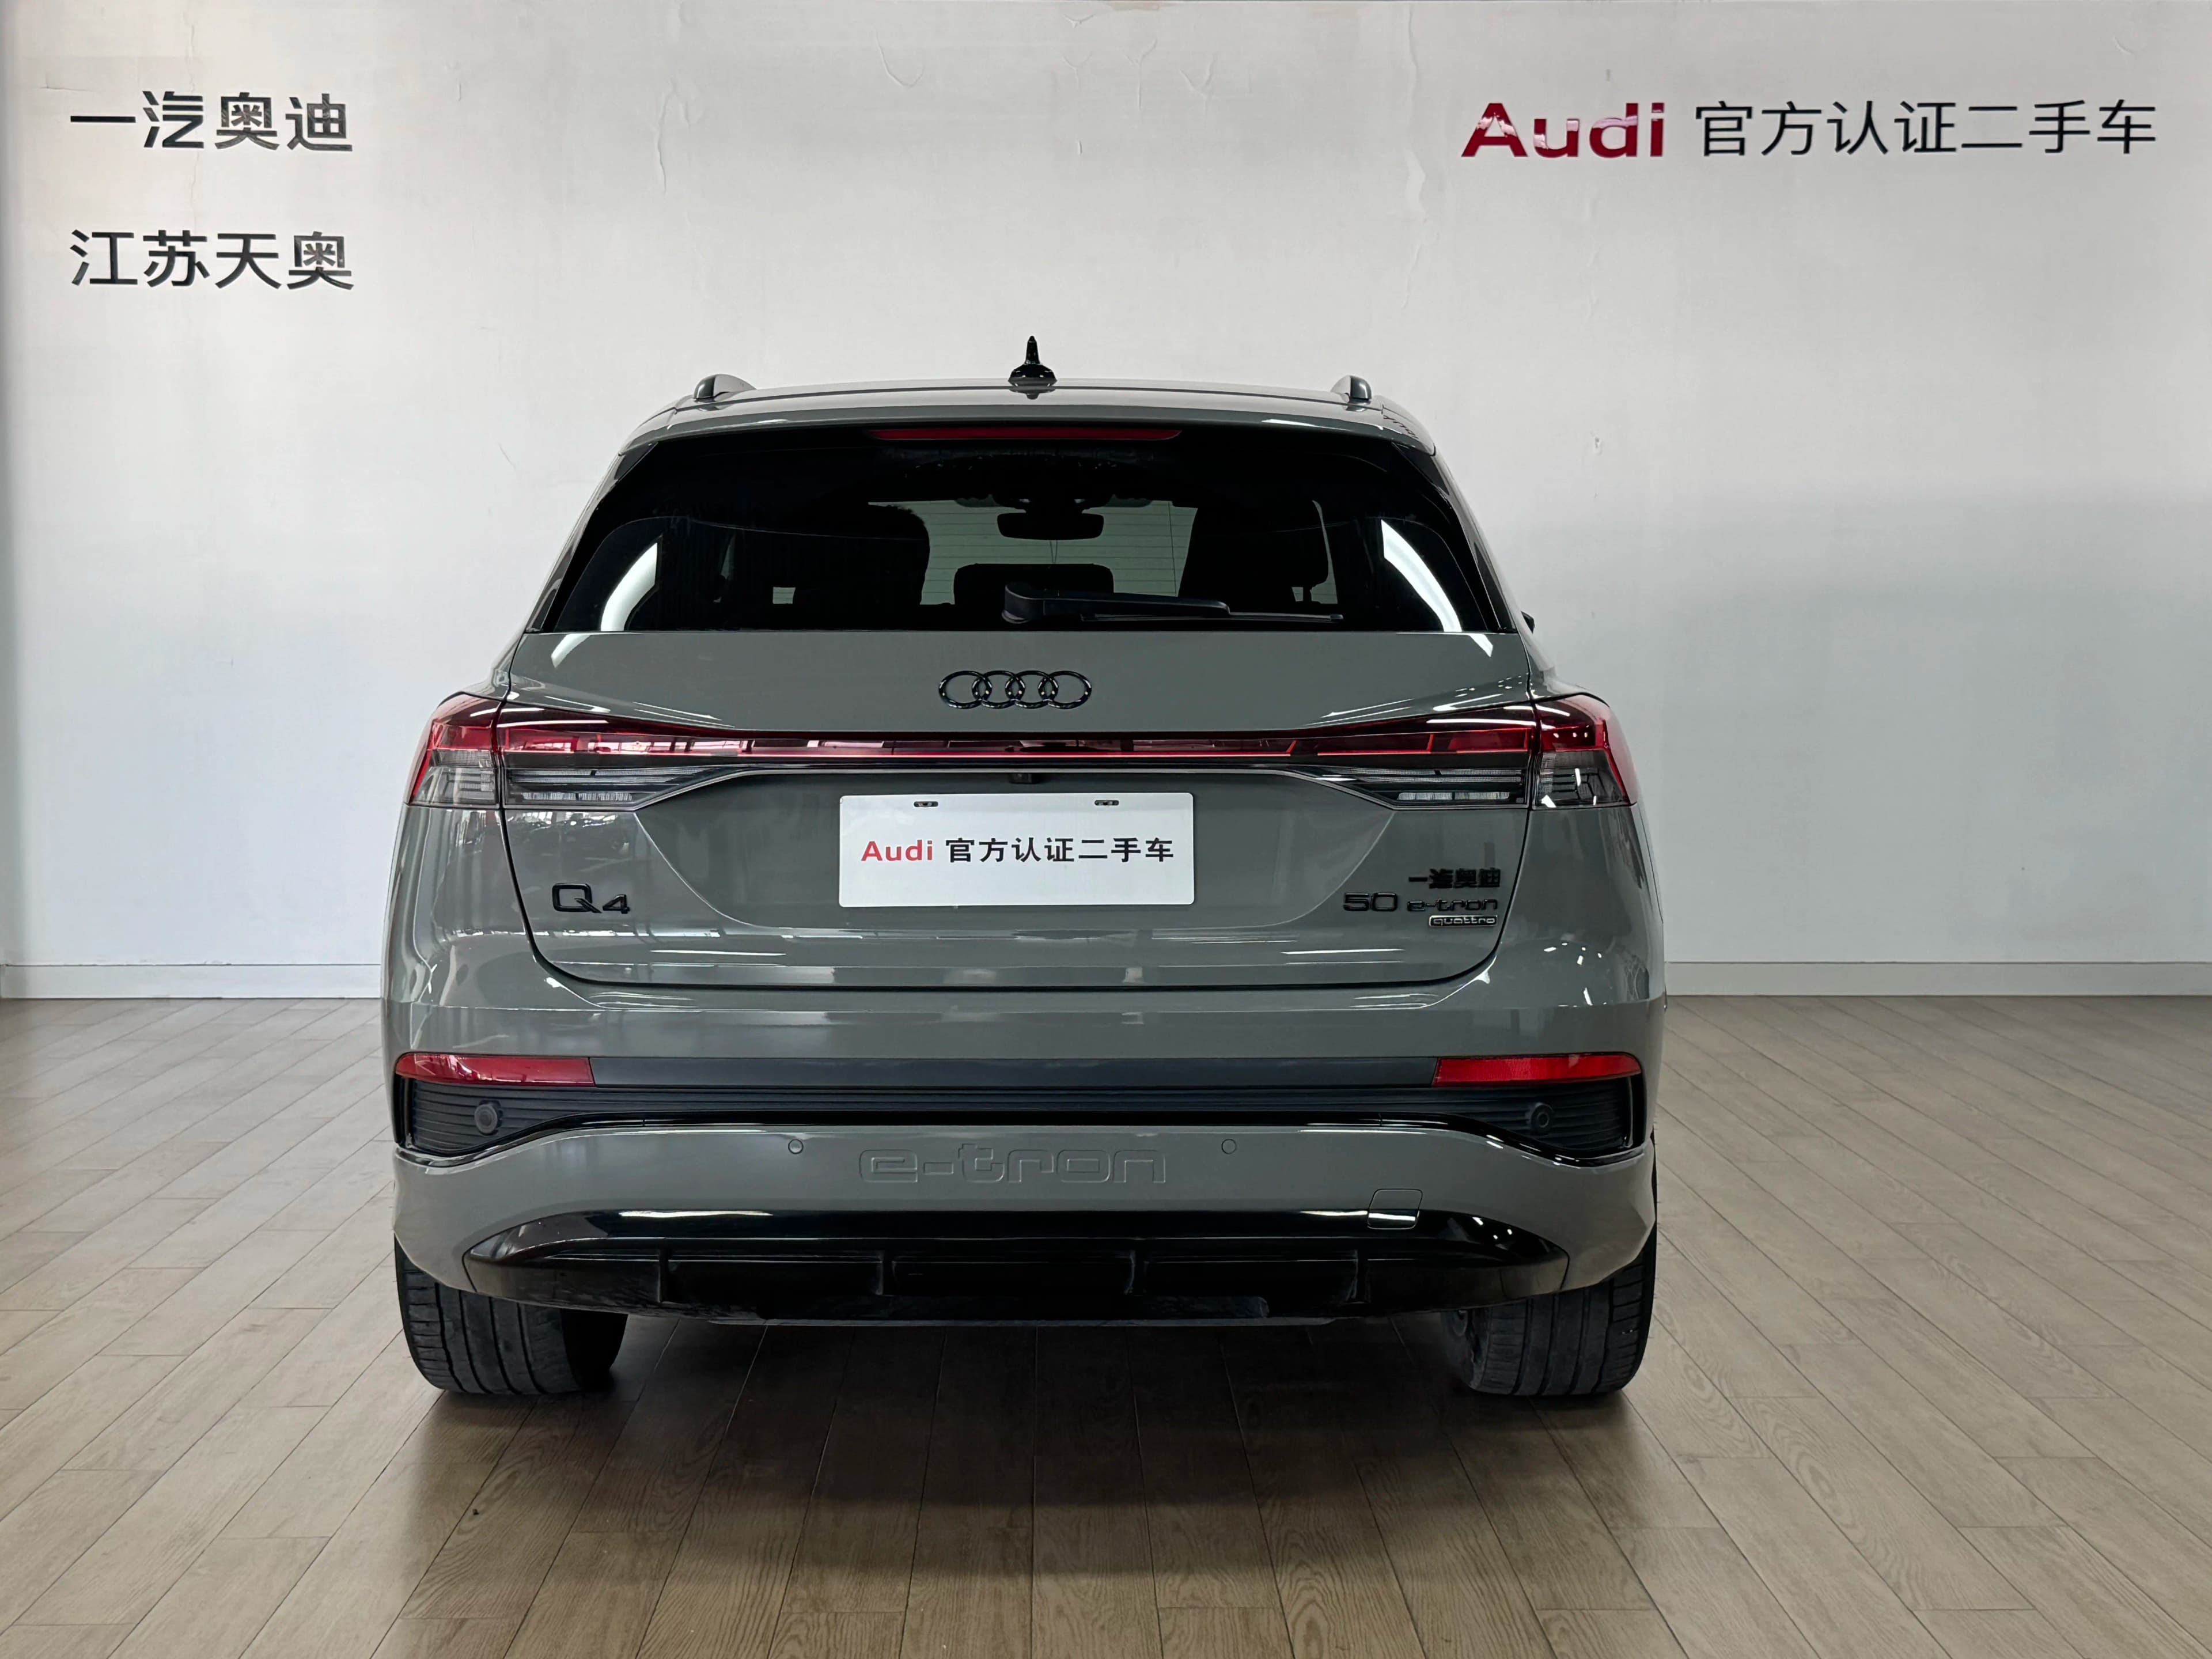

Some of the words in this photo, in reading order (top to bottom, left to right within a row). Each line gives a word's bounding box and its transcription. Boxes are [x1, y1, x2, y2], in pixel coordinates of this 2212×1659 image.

[70, 90, 353, 151] 一汽奥迪
[1461, 102, 1665, 158] Audi
[1695, 99, 2157, 156] 官方认证二手车
[70, 229, 354, 290] 江苏天奥
[861, 839, 933, 862] Audi
[945, 837, 1173, 862] 官方认证二手车
[552, 882, 630, 914] Q4
[1343, 892, 1398, 912] 50
[1407, 898, 1498, 912] e-tron
[1433, 916, 1495, 926] quattro
[858, 1143, 1166, 1183] e-tron
